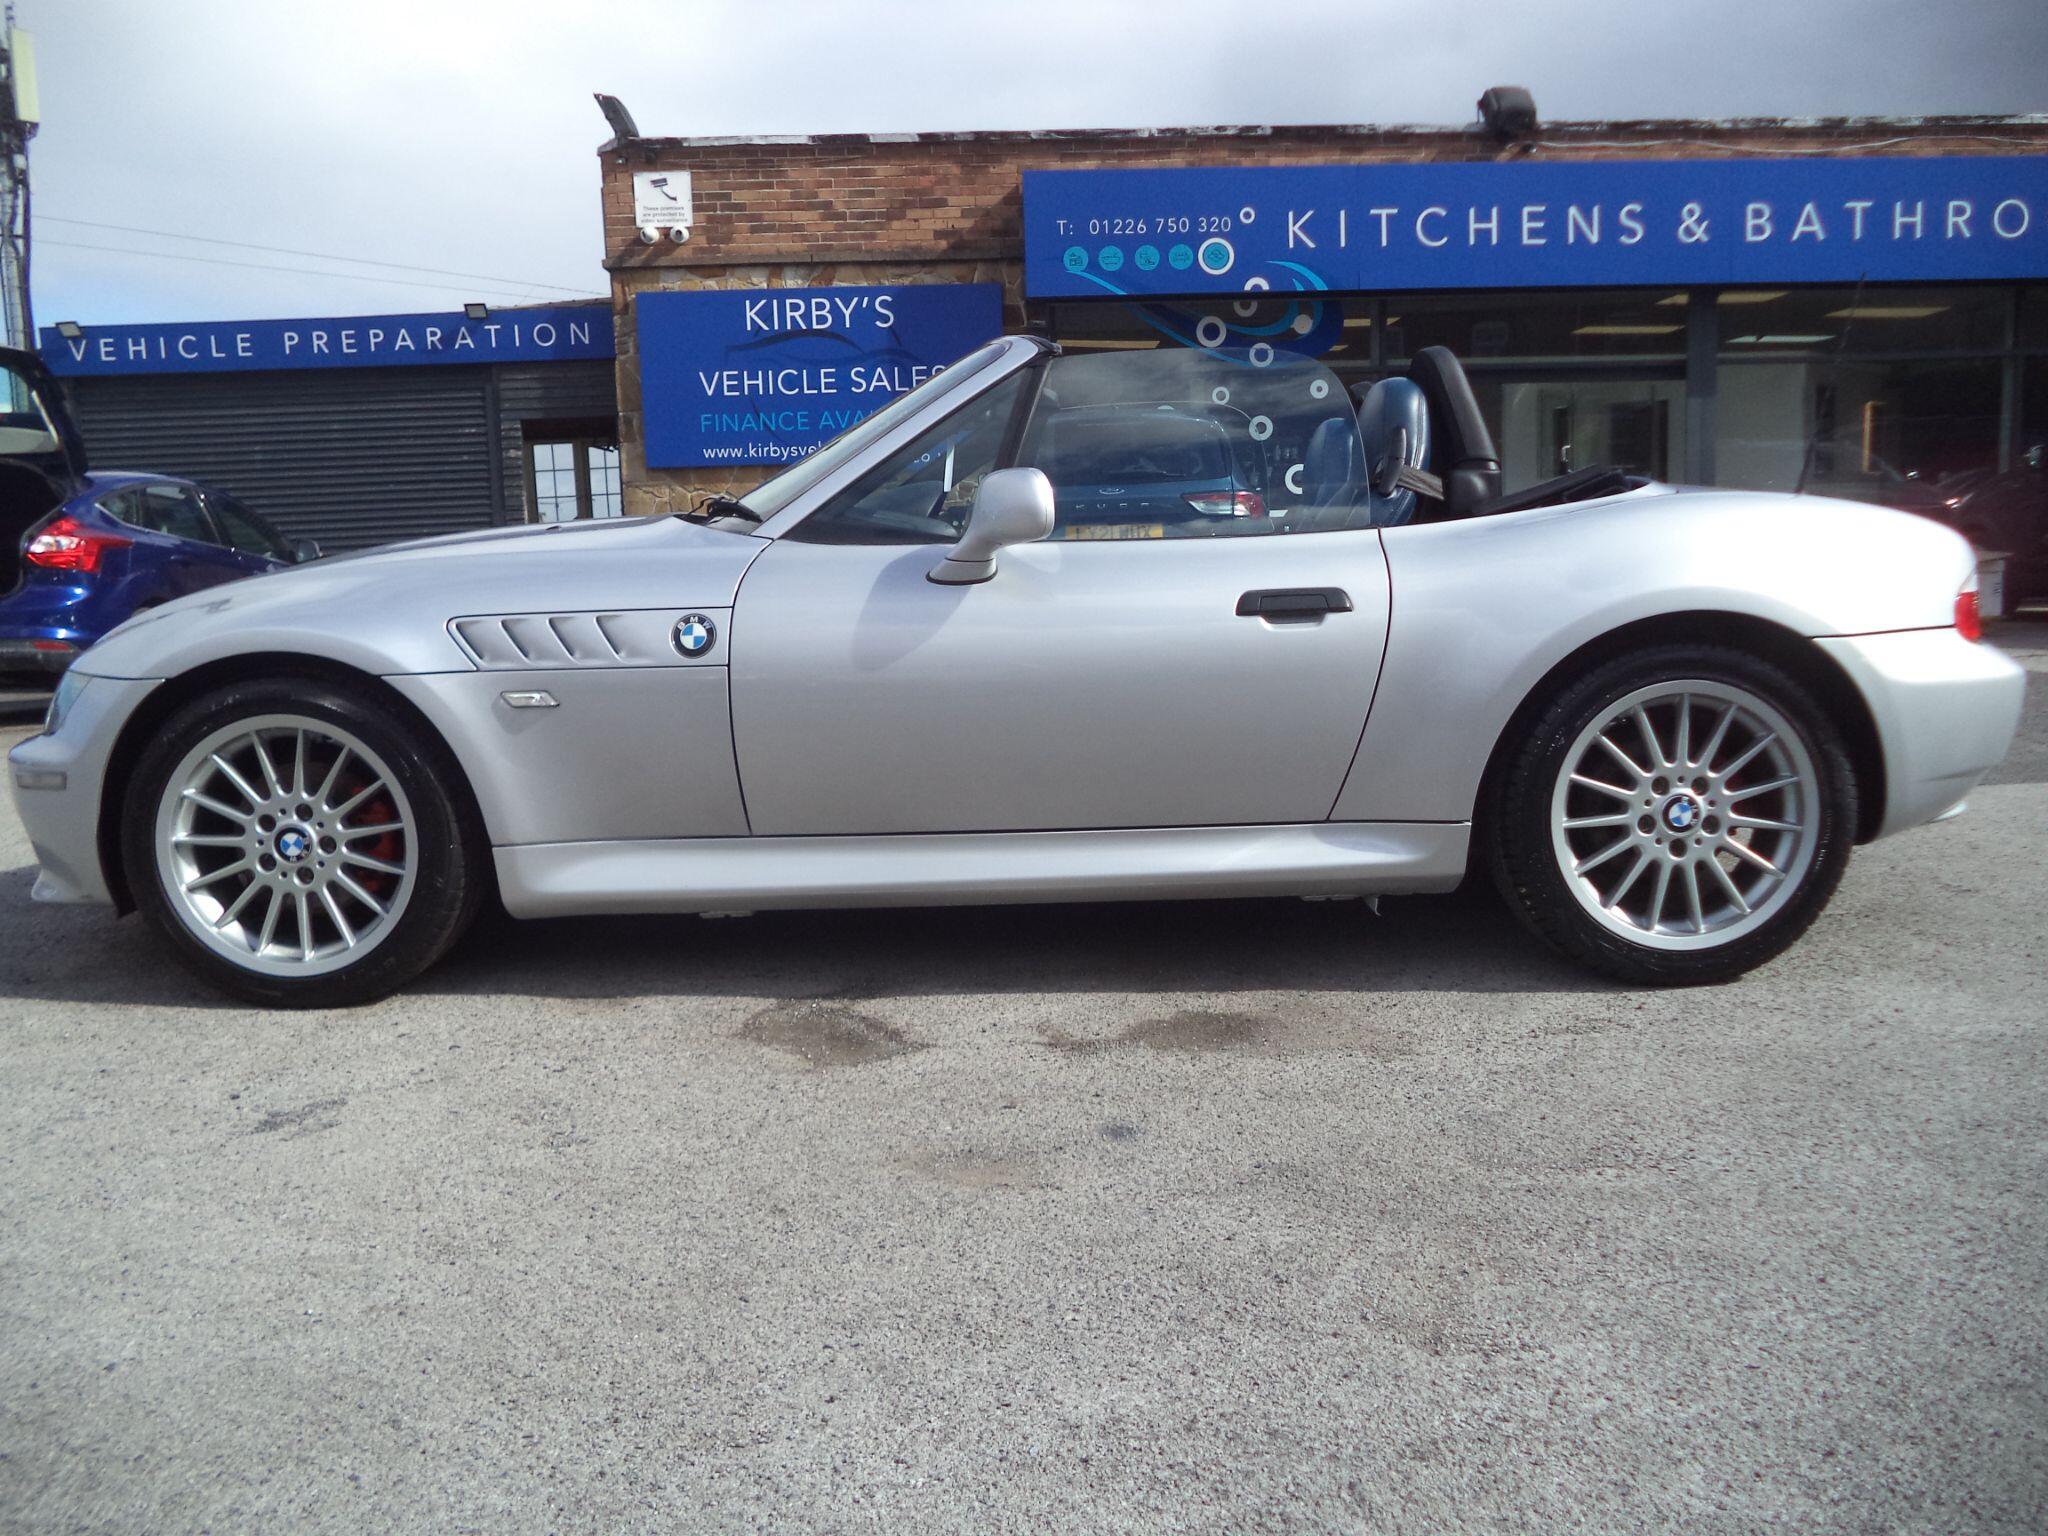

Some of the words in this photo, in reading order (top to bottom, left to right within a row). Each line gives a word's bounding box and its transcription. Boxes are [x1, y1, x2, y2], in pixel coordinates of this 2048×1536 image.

[1056, 219, 1074, 236] T:
[1089, 218, 1147, 235] 01226
[1155, 217, 1189, 234] 750
[1198, 216, 1231, 233] 320
[1288, 203, 1645, 249] KITCHENS
[1677, 202, 1709, 243] &
[1745, 199, 2030, 243] BATHRO
[745, 295, 895, 331] KIRBY'S
[68, 333, 253, 362] VEHICLE
[284, 322, 590, 355] PREPARATION
[698, 368, 838, 397] VEHICLE
[700, 411, 810, 433] FINANCE
[819, 409, 873, 430] AVA
[703, 440, 822, 461] www.kirbysve
[677, 616, 712, 631] BMW
